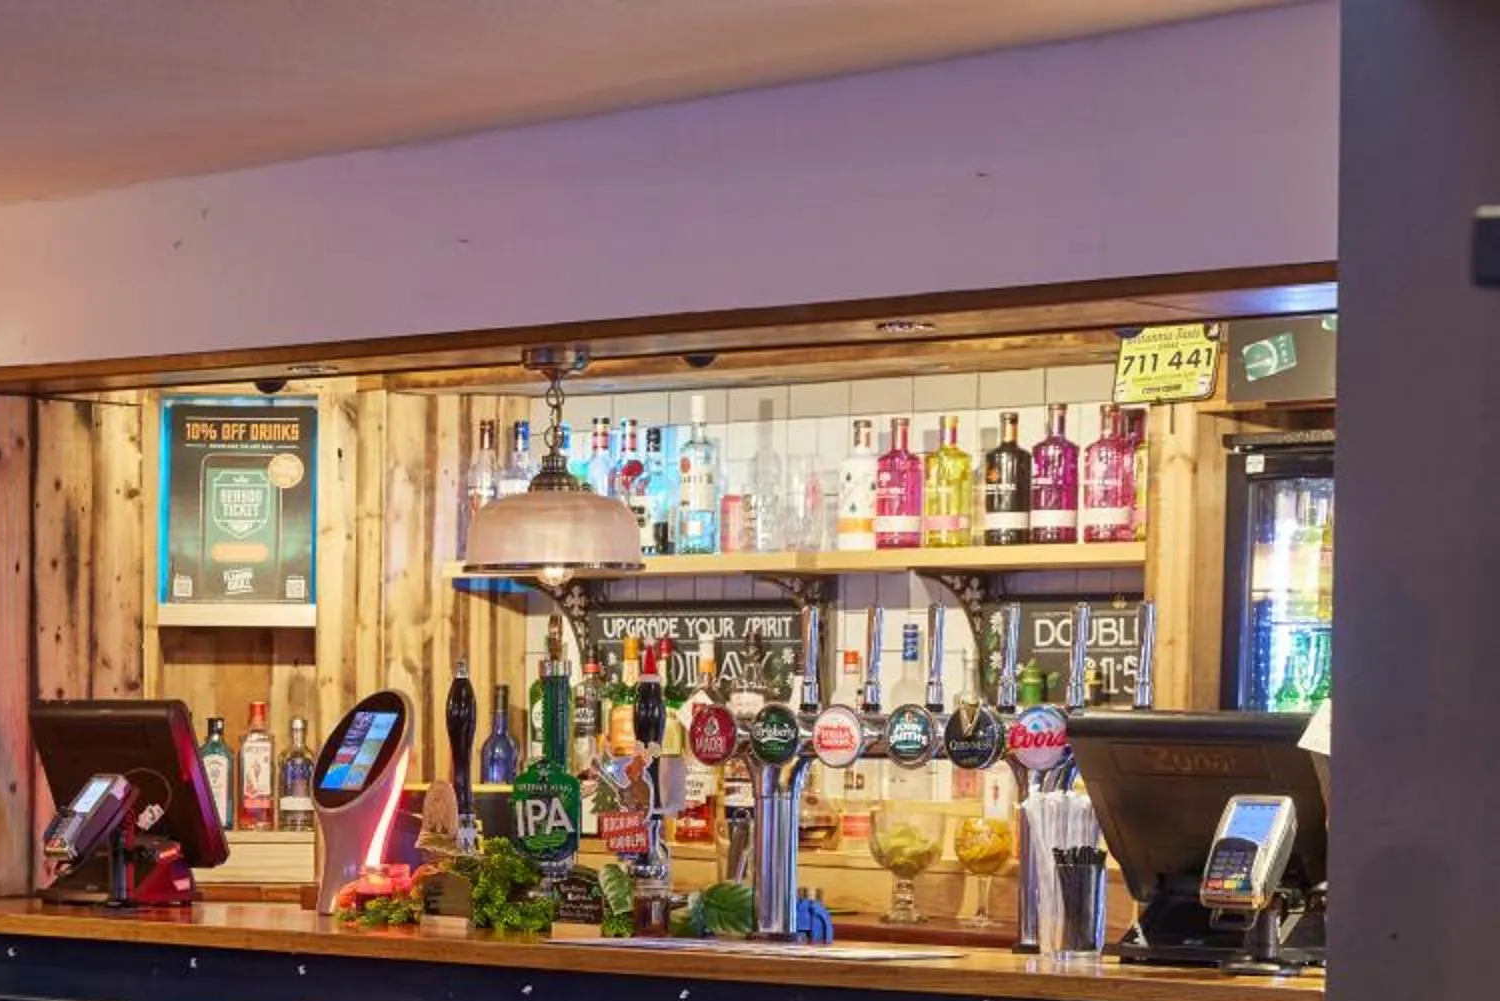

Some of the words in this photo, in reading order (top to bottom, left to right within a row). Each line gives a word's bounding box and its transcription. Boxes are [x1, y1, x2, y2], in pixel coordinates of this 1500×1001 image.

[1122, 352, 1159, 377] 711
[1167, 347, 1213, 370] 441
[186, 421, 218, 442] 10%
[222, 421, 247, 441] OFF
[250, 422, 300, 442] DRINKS
[603, 616, 679, 639] UPGRADE
[684, 616, 735, 639] YOUR
[742, 615, 793, 638] SPIRIT
[1035, 616, 1138, 647] DOUBL
[1008, 723, 1068, 749] Coors
[515, 796, 575, 837] IPA
